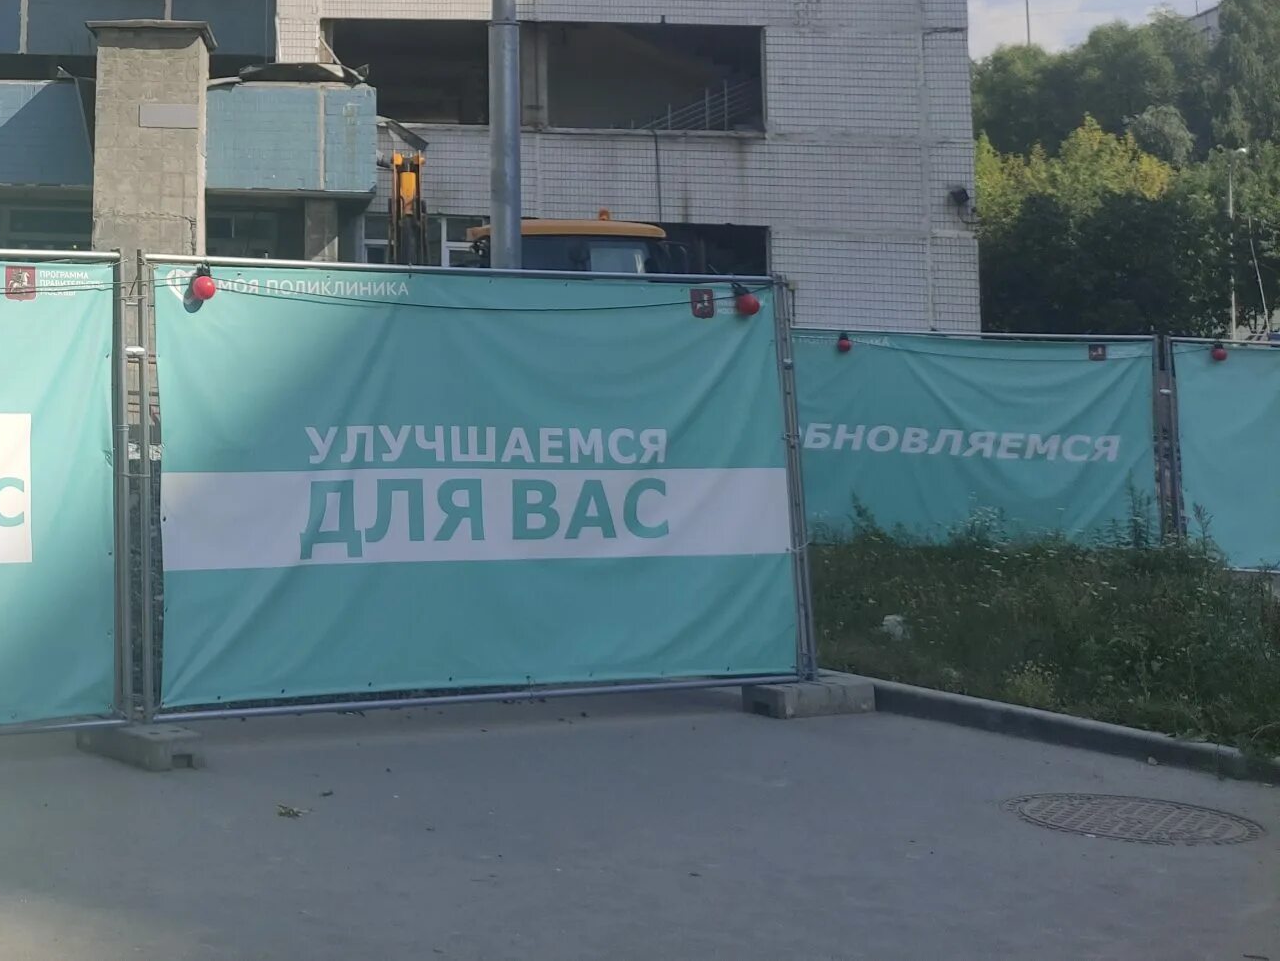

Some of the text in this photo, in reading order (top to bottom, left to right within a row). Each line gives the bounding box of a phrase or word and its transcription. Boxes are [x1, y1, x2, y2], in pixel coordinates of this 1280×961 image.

[39, 270, 89, 279] ПРОГРАММА
[218, 278, 410, 297] МОЯ ПОЛИКЛИНИКА
[305, 425, 668, 464] УЛУЧШАЕМСЯ
[797, 423, 1121, 463] БНОВЛЯЕМСЯ
[299, 477, 670, 561] ДЛЯ ВАС
